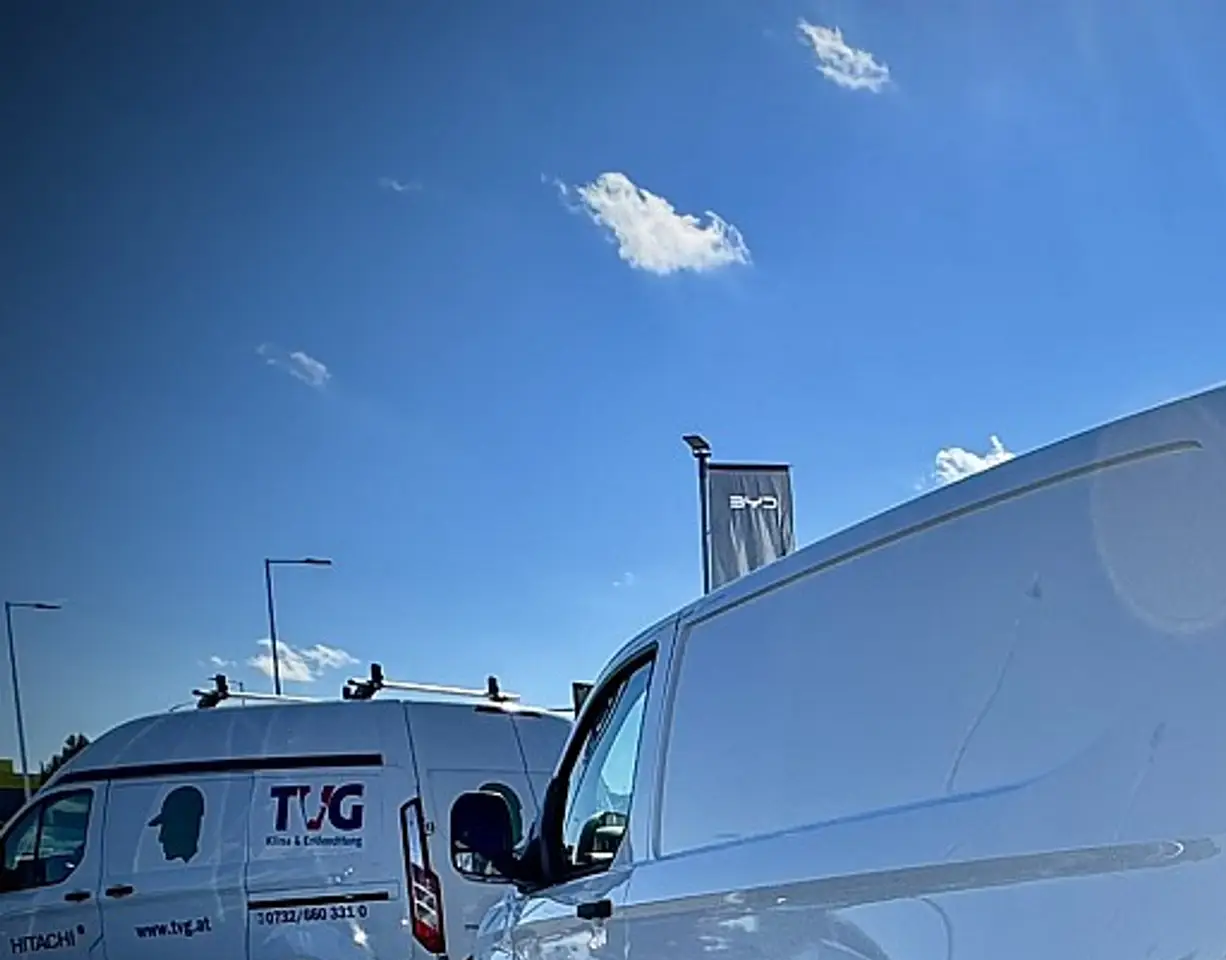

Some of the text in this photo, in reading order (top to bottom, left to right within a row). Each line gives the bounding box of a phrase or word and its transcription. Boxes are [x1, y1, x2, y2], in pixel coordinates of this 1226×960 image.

[729, 494, 778, 509] BYD
[270, 783, 364, 831] TVG
[358, 904, 368, 918] 0
[134, 916, 212, 938] www.tvg.at
[10, 930, 76, 955] HITACHI
